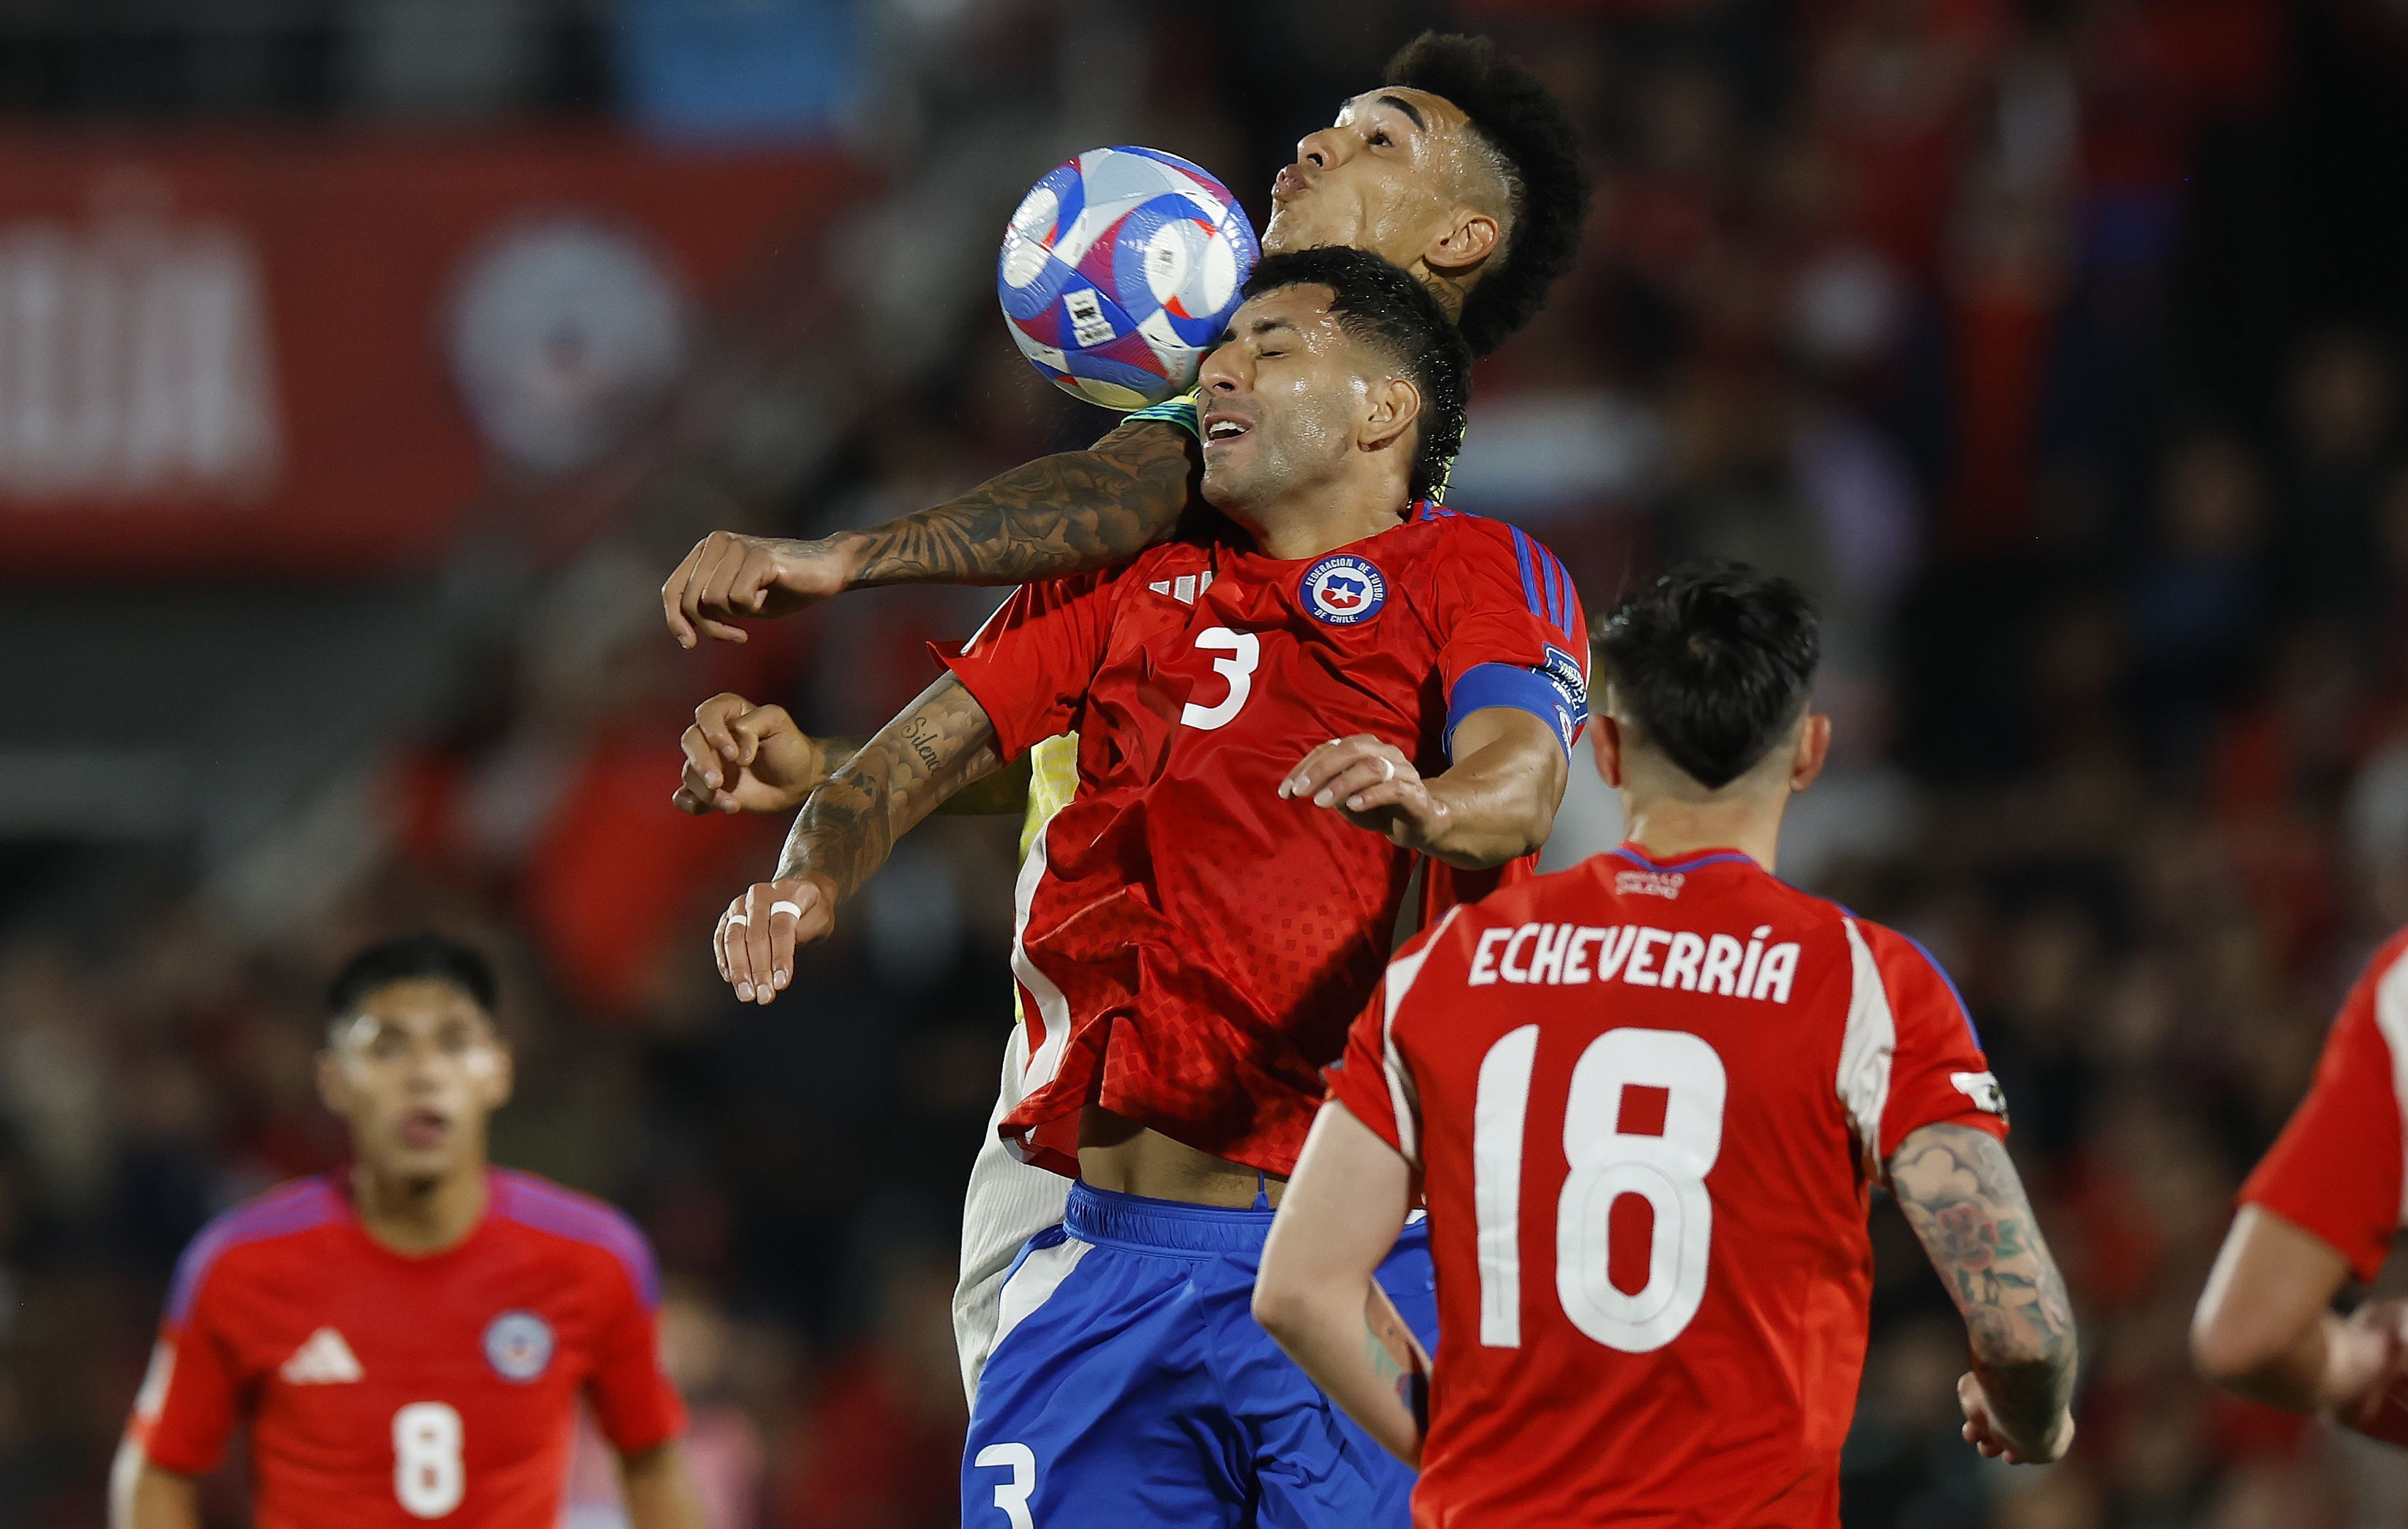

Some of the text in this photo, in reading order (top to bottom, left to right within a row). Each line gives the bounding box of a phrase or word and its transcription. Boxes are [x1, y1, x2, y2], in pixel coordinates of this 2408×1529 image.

[1305, 557, 1354, 586] FEDERACION
[1357, 562, 1371, 574] DE
[1314, 609, 1357, 623] DE CHILE
[1180, 627, 1260, 730] 3
[1468, 922, 1802, 1004] ECHEVERRÍA
[1473, 1023, 1727, 1353] 18
[391, 1401, 466, 1520] 8
[975, 1442, 1036, 1529] 3
